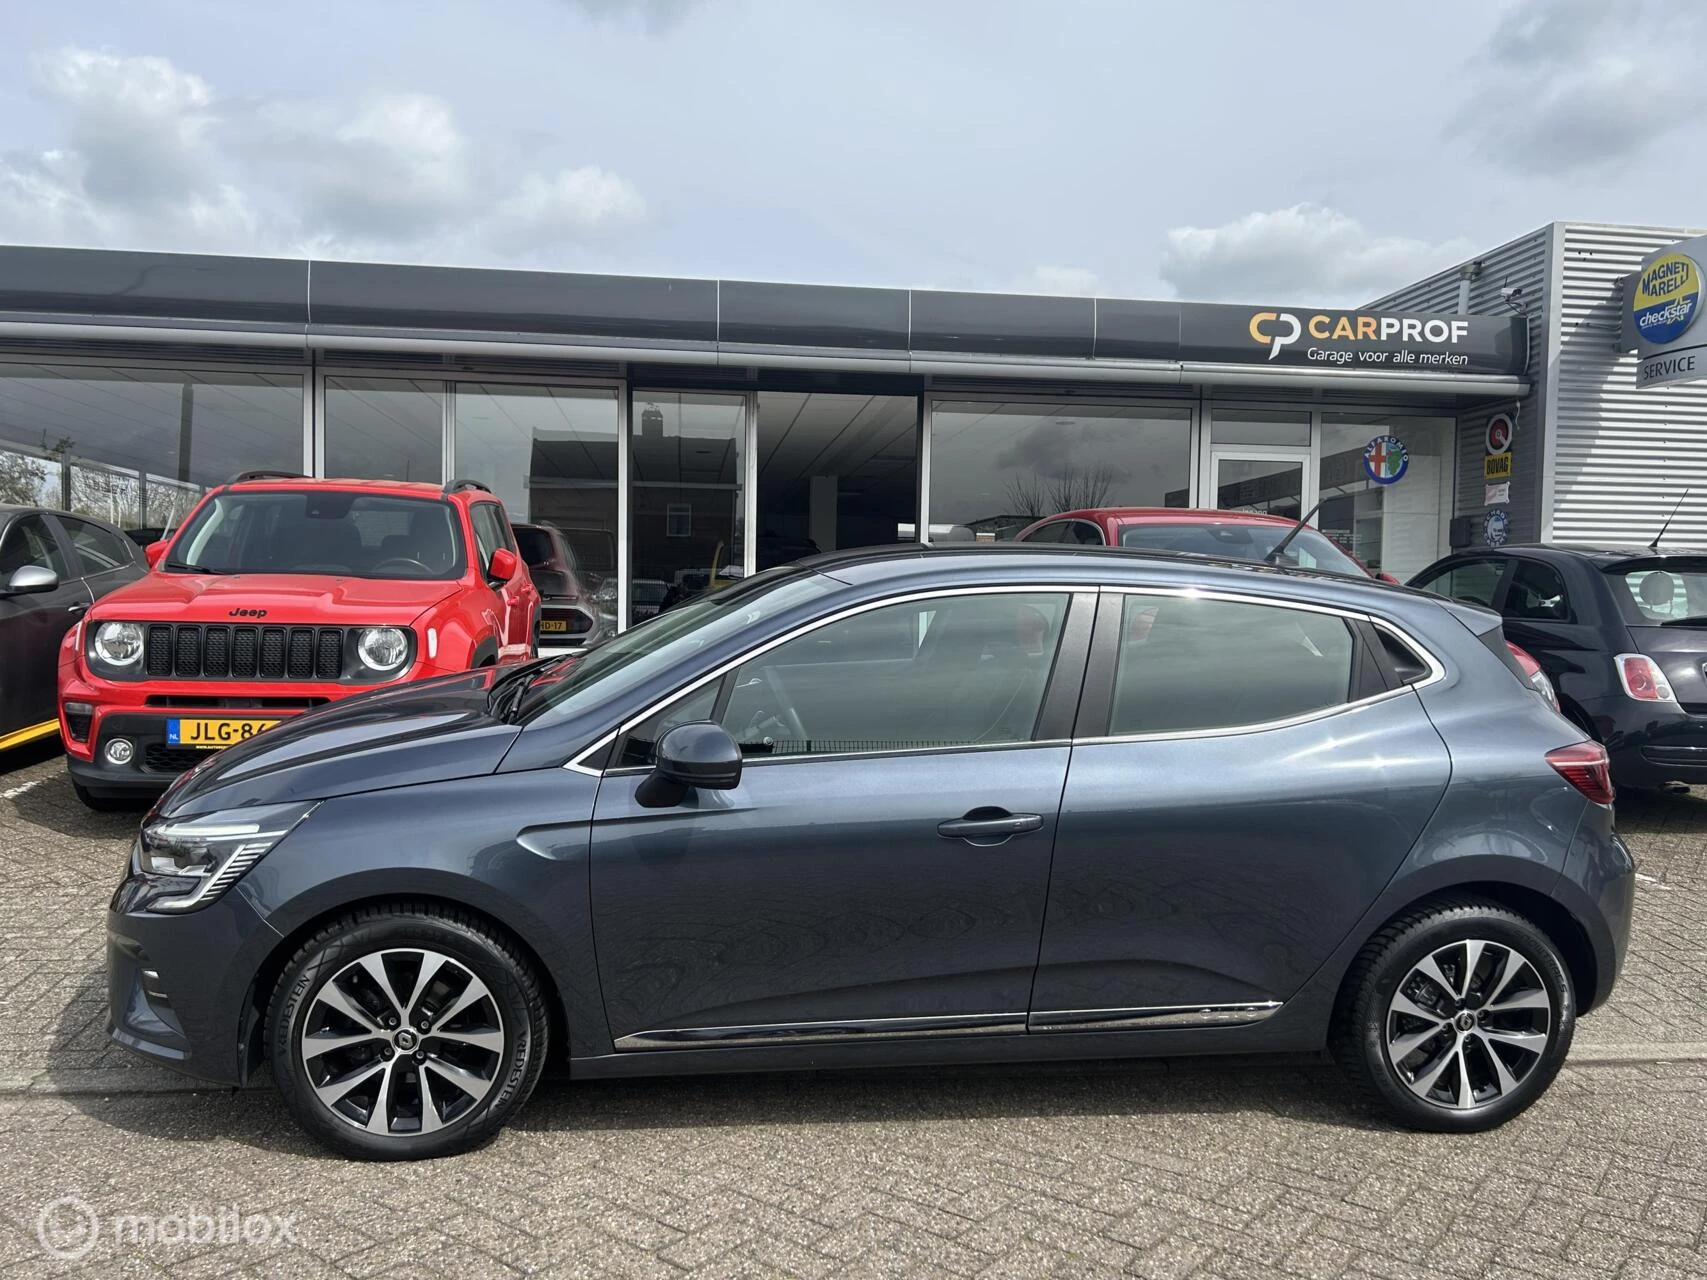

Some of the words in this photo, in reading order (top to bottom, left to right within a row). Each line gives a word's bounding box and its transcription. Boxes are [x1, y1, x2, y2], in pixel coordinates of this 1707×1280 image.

[1639, 302, 1692, 327] checkstar
[1308, 314, 1469, 343] CARPROF
[1307, 347, 1353, 364] Garage
[1358, 351, 1389, 362] voor
[1392, 349, 1415, 363] alle
[1419, 351, 1468, 365] merken
[1643, 355, 1696, 380] SERVICE
[1486, 456, 1509, 475] BOVAG
[228, 607, 267, 619] Jeep
